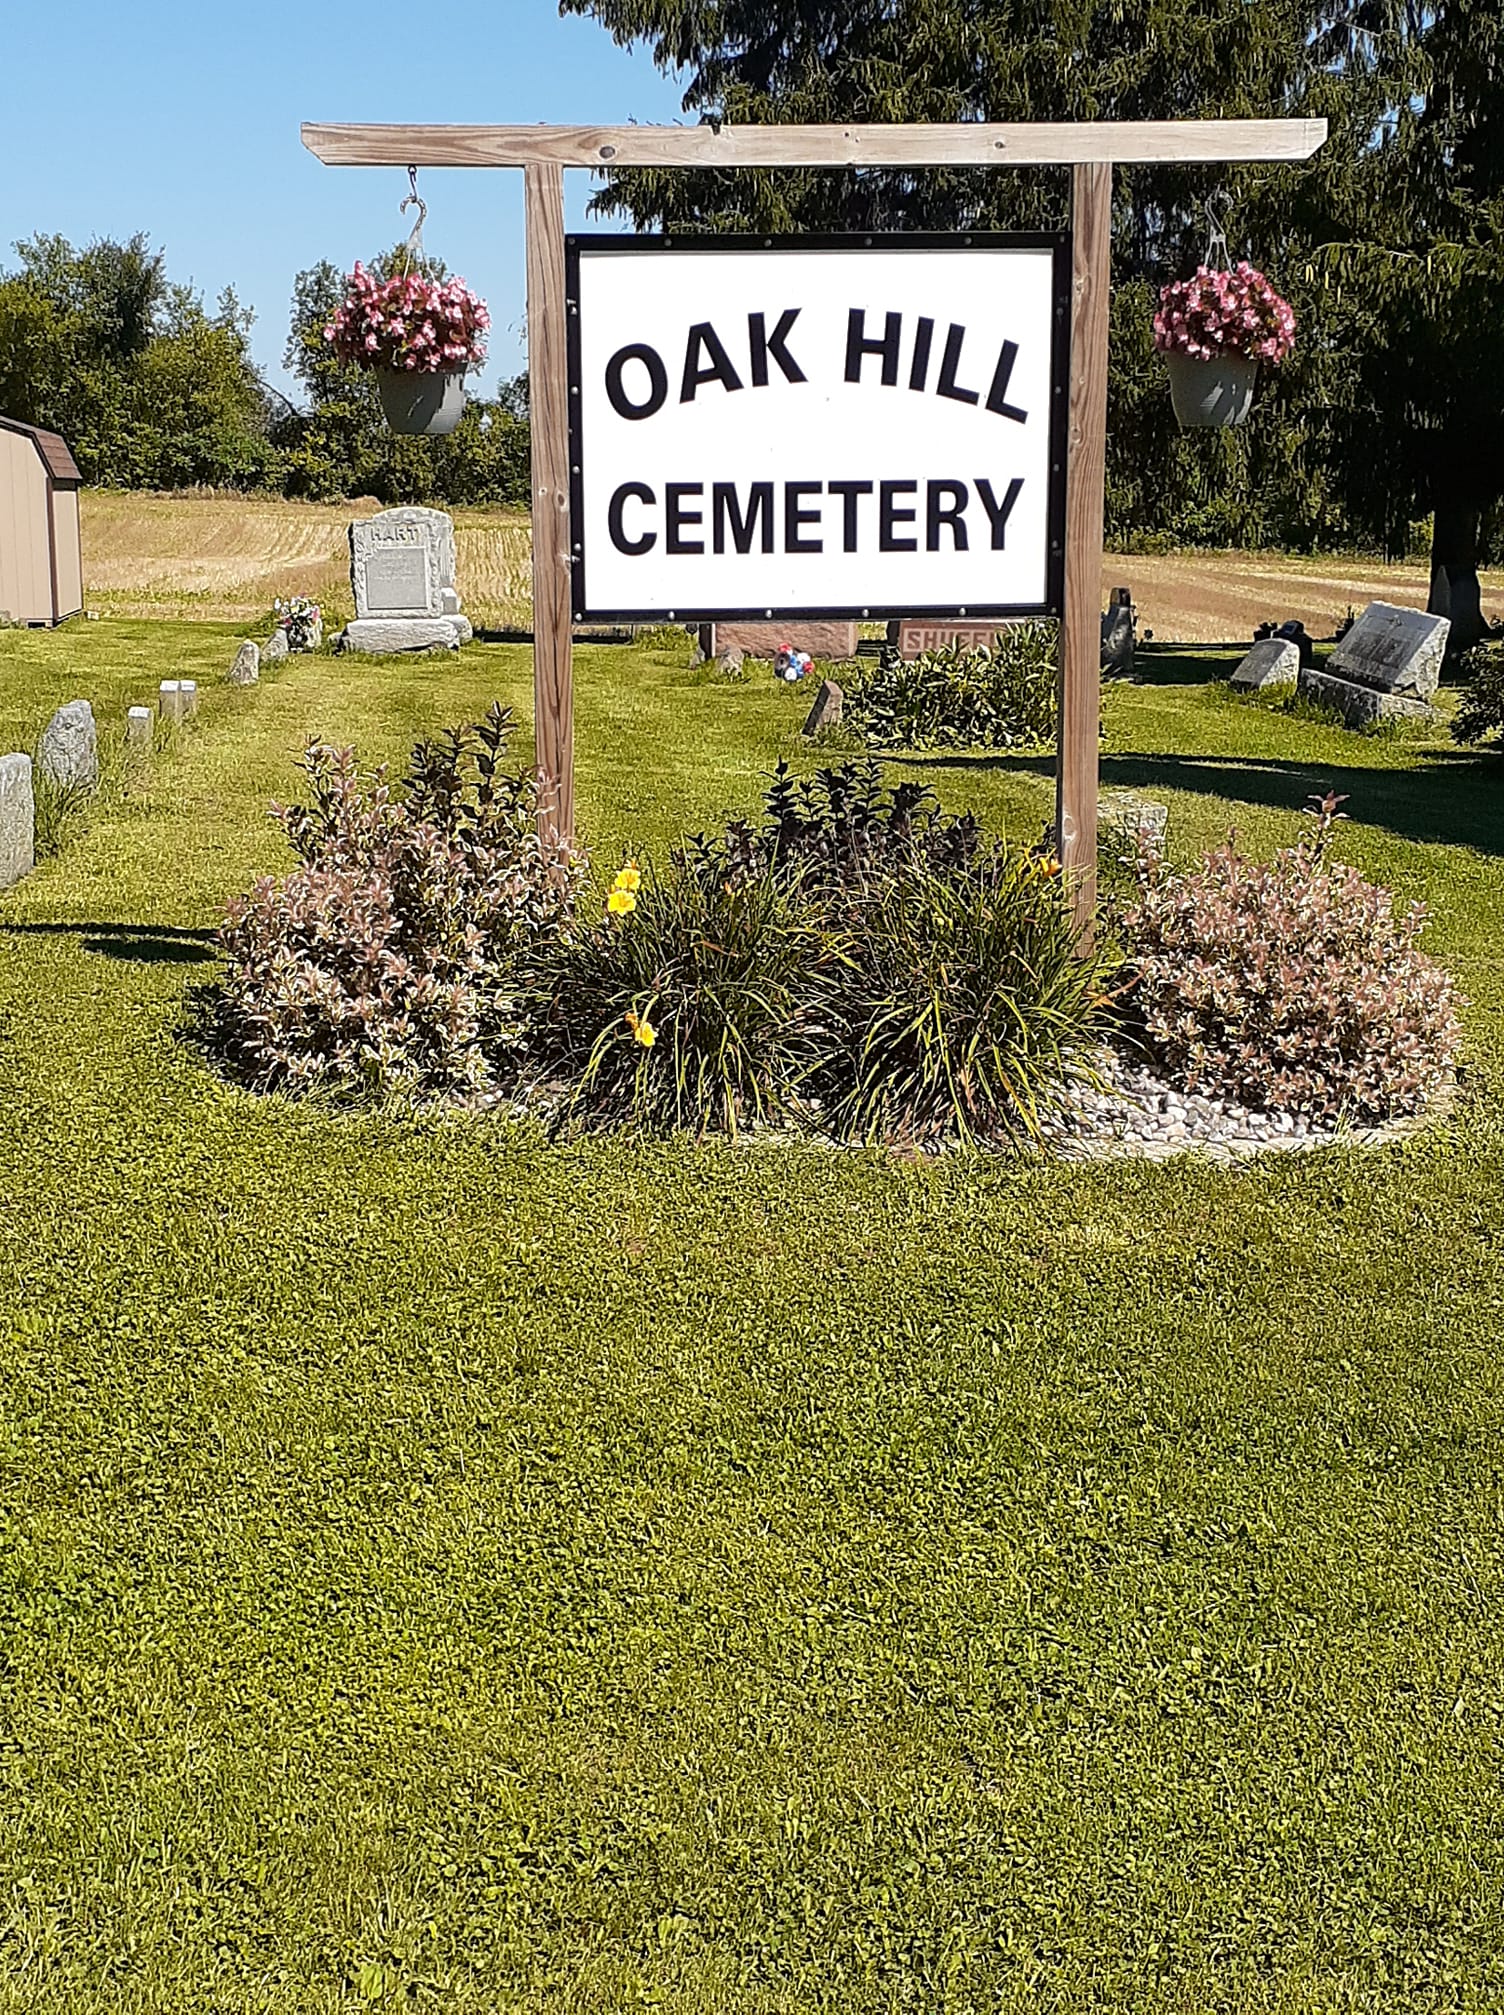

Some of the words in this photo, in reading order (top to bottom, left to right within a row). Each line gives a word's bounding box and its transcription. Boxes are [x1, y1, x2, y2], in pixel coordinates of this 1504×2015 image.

[605, 308, 808, 420] OAK
[844, 308, 1028, 424] HILL
[370, 527, 418, 541] HART
[608, 478, 1025, 556] CEMETERY
